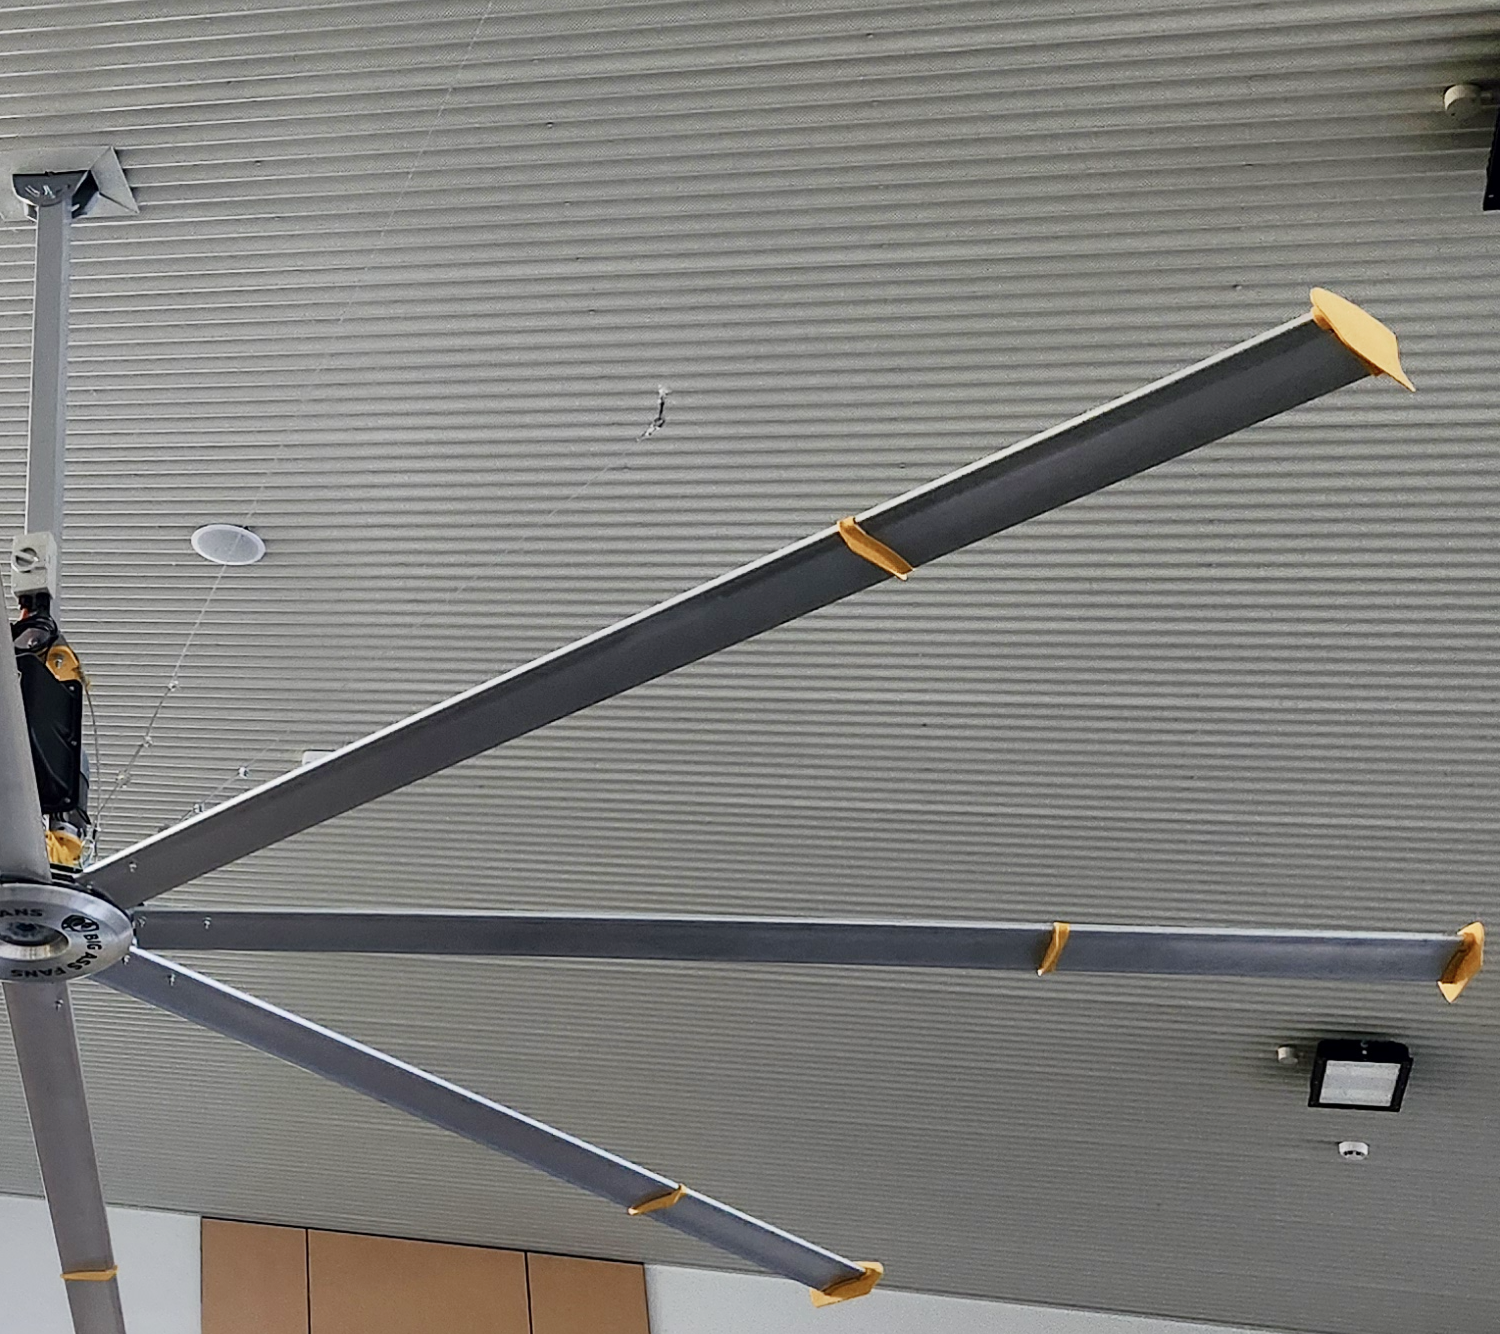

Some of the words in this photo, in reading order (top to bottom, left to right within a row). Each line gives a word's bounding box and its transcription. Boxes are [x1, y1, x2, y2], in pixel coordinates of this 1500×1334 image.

[84, 934, 102, 951] BIG
[68, 952, 98, 970] ASS
[11, 967, 66, 977] FANS
